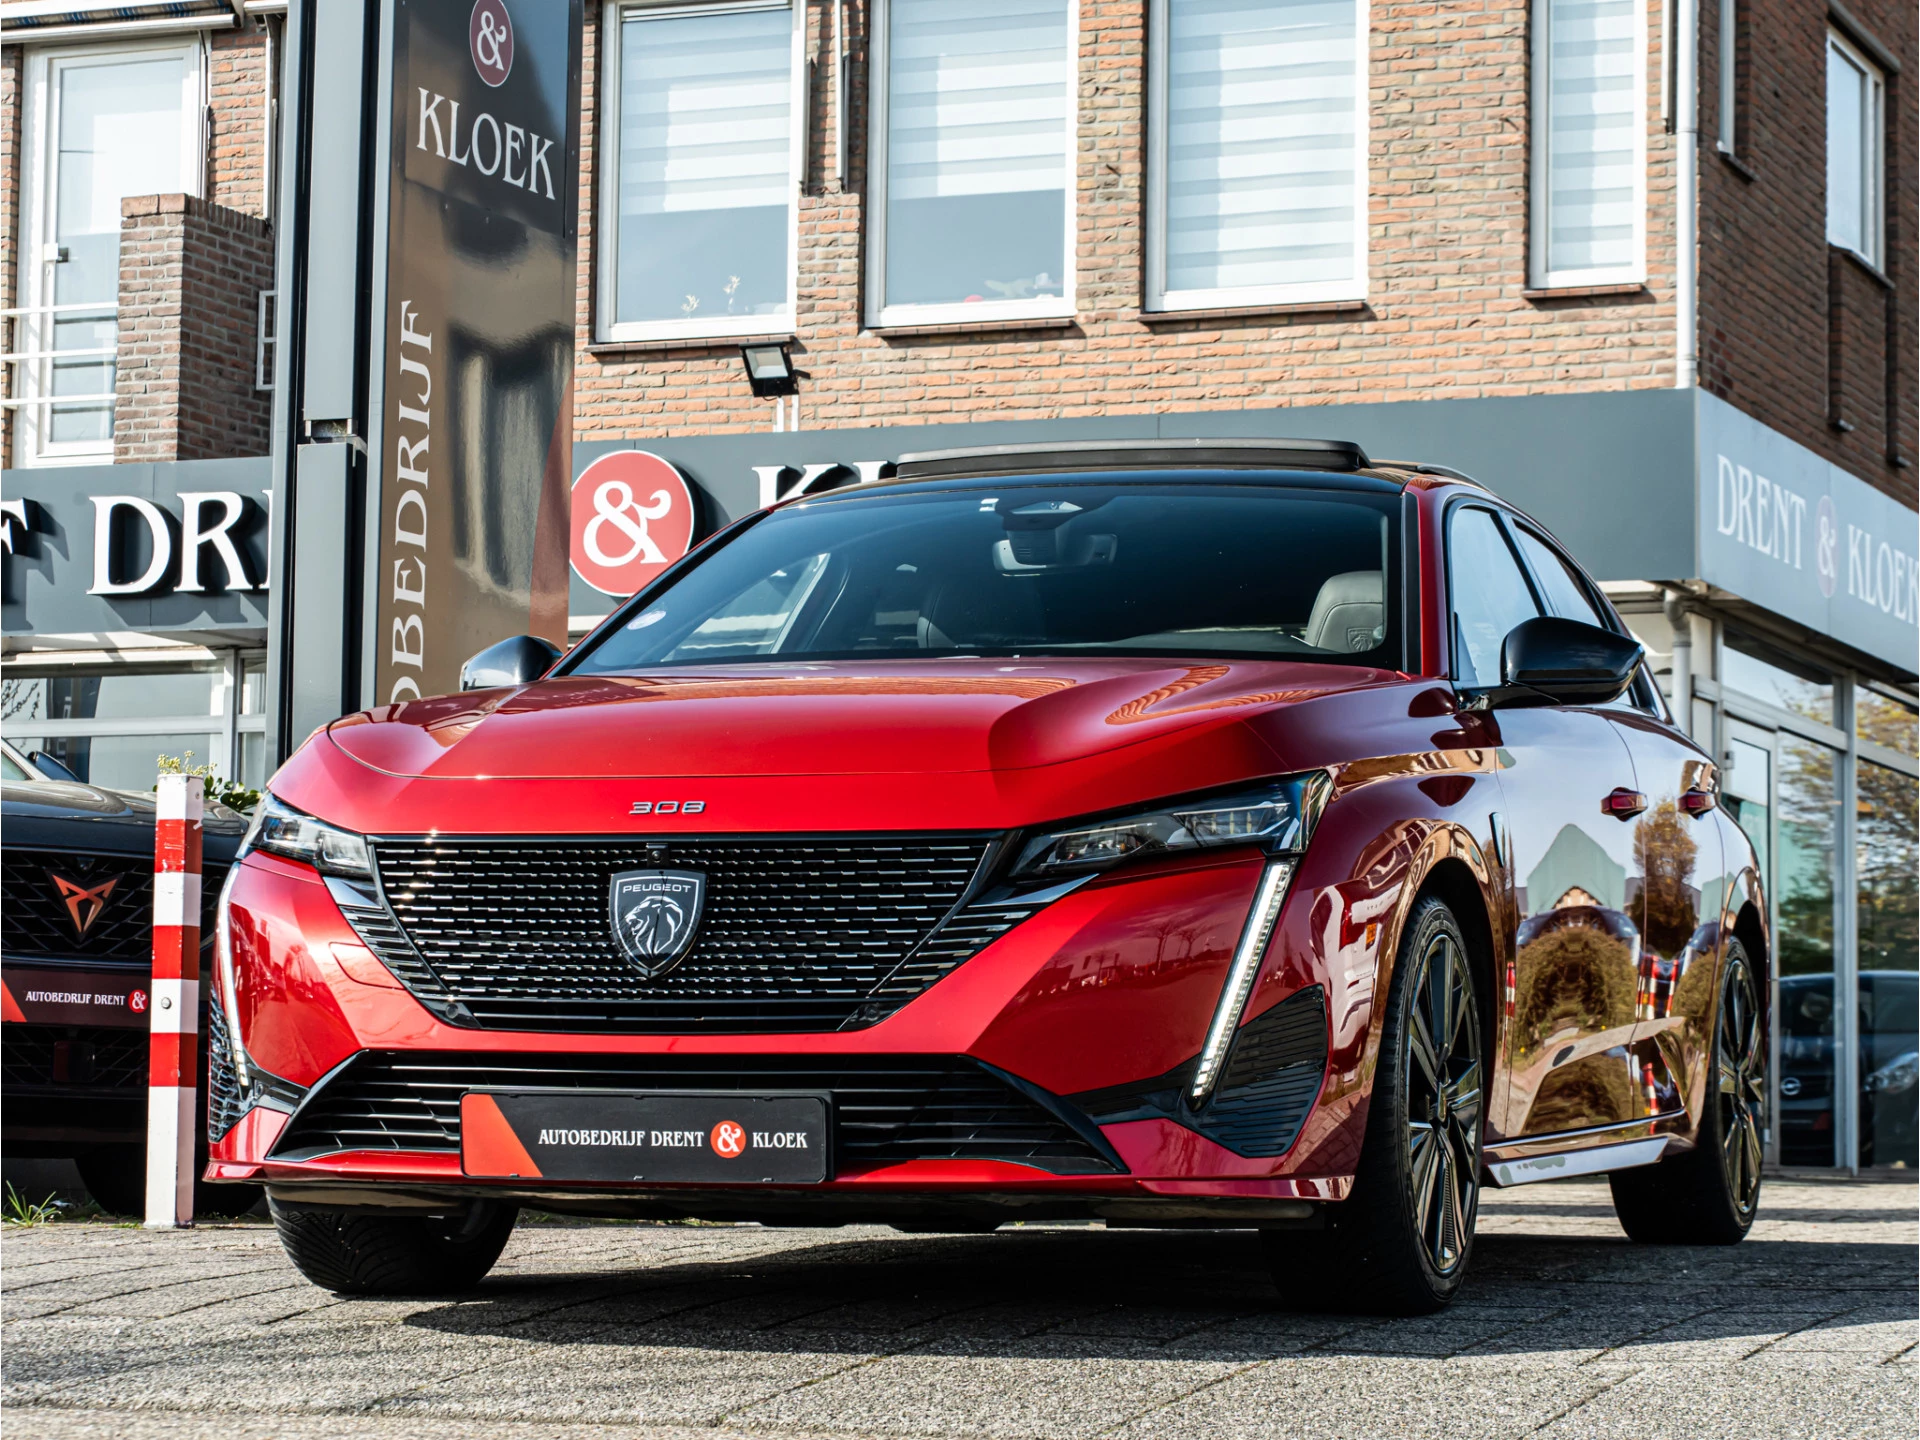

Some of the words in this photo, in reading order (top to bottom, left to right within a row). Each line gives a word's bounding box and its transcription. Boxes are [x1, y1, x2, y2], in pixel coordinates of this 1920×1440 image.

[477, 10, 507, 71] &
[416, 86, 556, 201] KLOEK
[86, 489, 273, 595] DR
[582, 480, 672, 567] &
[1717, 453, 1807, 571] DRENT
[1818, 515, 1836, 579] &
[628, 801, 707, 815] 308
[622, 883, 692, 894] PEUGEOT
[25, 991, 92, 1005] AUTOBEDRIJF
[94, 994, 126, 1006] DRENT
[131, 991, 146, 1010] &
[538, 1129, 646, 1147] AUTOBEDRIJF
[650, 1130, 705, 1148] DRENT
[717, 1124, 742, 1153] &
[752, 1132, 808, 1149] KLOEK
